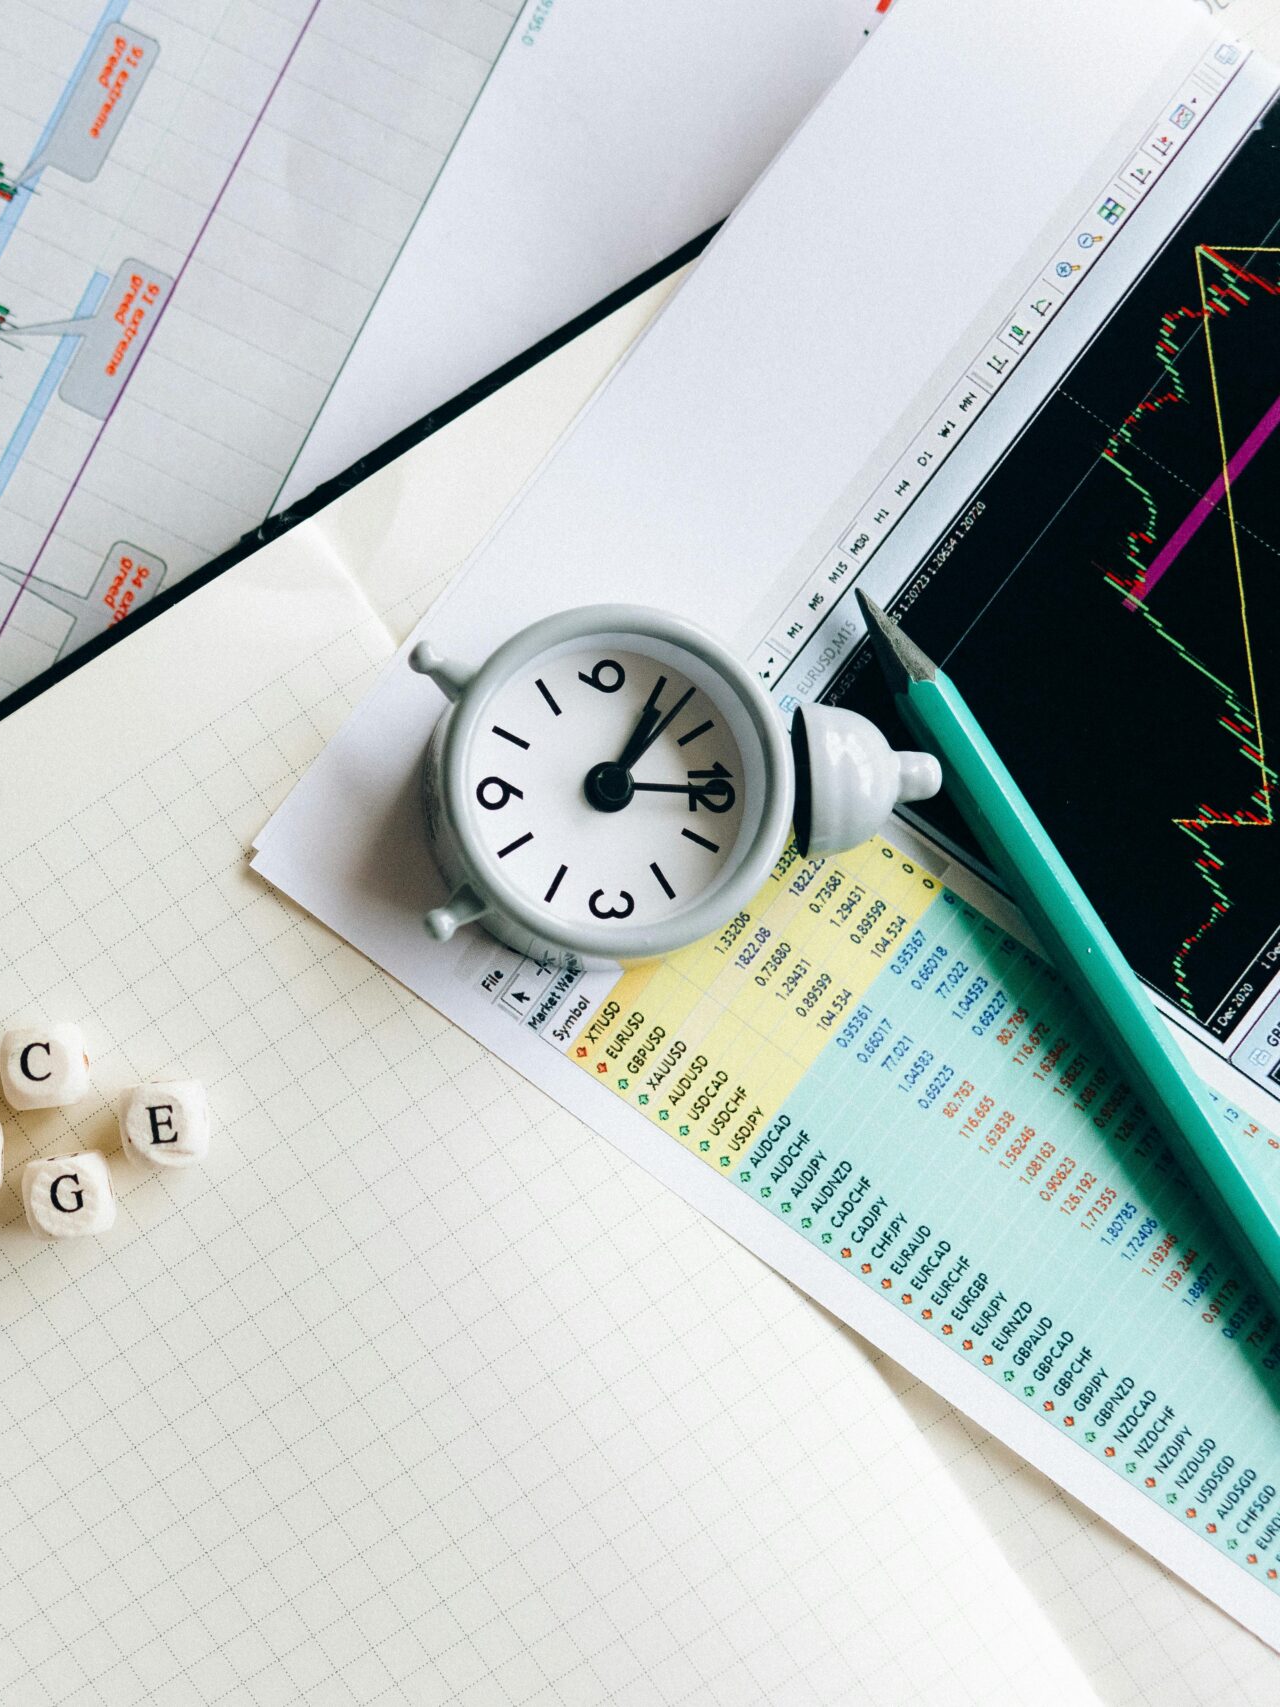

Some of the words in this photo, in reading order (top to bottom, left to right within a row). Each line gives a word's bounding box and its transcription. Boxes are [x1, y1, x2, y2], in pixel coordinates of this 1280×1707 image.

[97, 36, 128, 89] greed
[125, 46, 145, 68] 91
[89, 69, 130, 139] extreme
[113, 274, 144, 326] greed
[140, 283, 161, 306] 91
[105, 307, 146, 377] extreme
[786, 621, 804, 640] M1
[807, 592, 825, 612] M5
[827, 560, 849, 585] M15
[849, 533, 870, 556] M30
[873, 507, 890, 525] H1
[894, 479, 911, 497] H4
[916, 450, 934, 468] D1
[958, 391, 978, 413] MN
[102, 556, 135, 610] greed
[130, 566, 150, 590] 94
[898, 573, 931, 612] 1.20723
[926, 537, 958, 576] 1.20654
[954, 500, 987, 539] 1.20720
[578, 658, 626, 694] 9
[795, 619, 858, 696] EURUSD,M15
[476, 776, 524, 811] 6
[687, 760, 735, 814] 12
[588, 888, 635, 920] 3
[480, 969, 505, 993] File
[626, 1025, 667, 1075] GBPUSD
[713, 910, 751, 955] 1.33206
[667, 1054, 709, 1107] AUDUSD
[753, 941, 792, 987] 0.73680
[808, 869, 846, 914] 0.73681
[687, 1070, 729, 1121] USDCAD
[775, 958, 812, 1001] 1.29431
[829, 884, 867, 928] 1.29431
[1231, 982, 1254, 1008] 2020
[527, 991, 562, 1031] Market
[551, 994, 592, 1042] Symbol
[584, 1000, 621, 1045] XTIUSD
[605, 1011, 646, 1060] EURUSD
[645, 1040, 688, 1092] XAUUSD
[734, 926, 772, 970] 1822.08
[707, 1085, 748, 1137] USDCHF
[795, 972, 833, 1018] 0.89599
[849, 899, 888, 945] 0.89599
[727, 1105, 765, 1152] USDJPY
[816, 988, 853, 1031] 104.534
[870, 914, 907, 959] 104.534
[1211, 1026, 1222, 1035] 1
[1216, 1006, 1237, 1027] Dec
[749, 1114, 792, 1169] AUDCAD
[835, 1004, 873, 1049] 0.95361
[769, 1129, 811, 1184] AUDCHF
[856, 1017, 893, 1064] 0.66017
[789, 1149, 828, 1199] AUDJPY
[880, 1034, 914, 1072] 77.021
[809, 1160, 853, 1215] AUDNZD
[897, 1049, 935, 1093] 1.04583
[829, 1175, 872, 1229] CADCHF
[917, 1064, 955, 1110] 0.69225
[850, 1195, 889, 1244] CADJPY
[941, 1079, 976, 1119] 80.763
[870, 1212, 909, 1260] CHFJPY
[958, 1095, 996, 1139] 116.665
[889, 1224, 932, 1276] EURAUD
[978, 1110, 1016, 1155] 1.63838
[909, 1239, 952, 1291] EURCAD
[998, 1125, 1036, 1170] 1.56246
[930, 1255, 971, 1306] EURCHF
[1018, 1141, 1057, 1186] 1.08163
[950, 1272, 990, 1322] EURGBP
[1038, 1156, 1077, 1202] 0.90623
[970, 1291, 1008, 1337] EURJPY
[1059, 1171, 1098, 1216] 126.192
[991, 1300, 1033, 1352] EURNZD
[1080, 1186, 1118, 1231] 1.71355
[1012, 1316, 1054, 1367] GBPAUD
[1100, 1201, 1138, 1246] 1.80785
[1032, 1330, 1075, 1382] GBPCAD
[1052, 1346, 1094, 1397] GBPCHF
[1073, 1367, 1110, 1413] GBPJPY
[1093, 1376, 1136, 1428] GBPNZD
[1112, 1389, 1157, 1444] NZDCAD
[1133, 1405, 1176, 1459] NZDCHF
[1153, 1425, 1193, 1475] NZDJPY
[1174, 1438, 1217, 1490] NZDUSD
[1194, 1455, 1236, 1505] USDSGD
[1215, 1468, 1258, 1521] AUDSGD
[1235, 1484, 1277, 1535] CHFSGD
